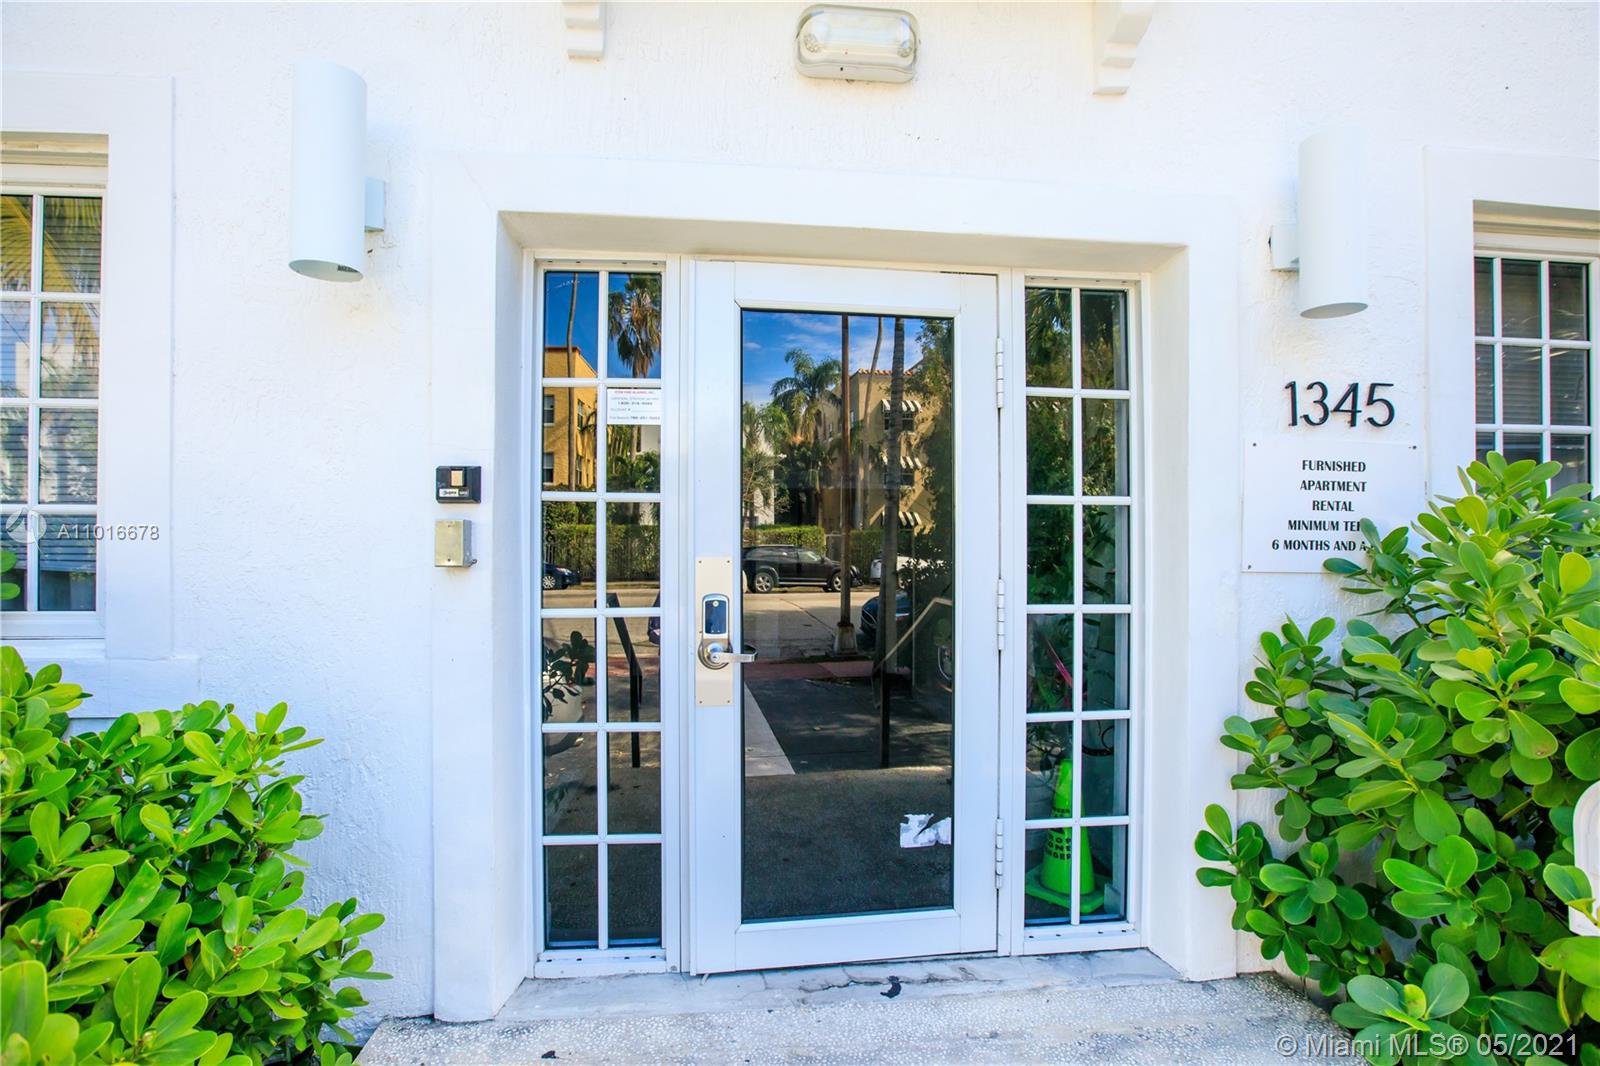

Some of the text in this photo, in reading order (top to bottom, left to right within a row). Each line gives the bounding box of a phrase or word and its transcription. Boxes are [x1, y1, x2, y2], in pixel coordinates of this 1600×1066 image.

[1284, 381, 1395, 427] 1345
[1302, 460, 1366, 472] FURNISHED
[1300, 480, 1367, 492] APARTMENT
[1312, 500, 1354, 512] RENTAL
[1288, 520, 1360, 532] MINIMUM TE
[1272, 539, 1367, 551] 6 MONTHS AND A
